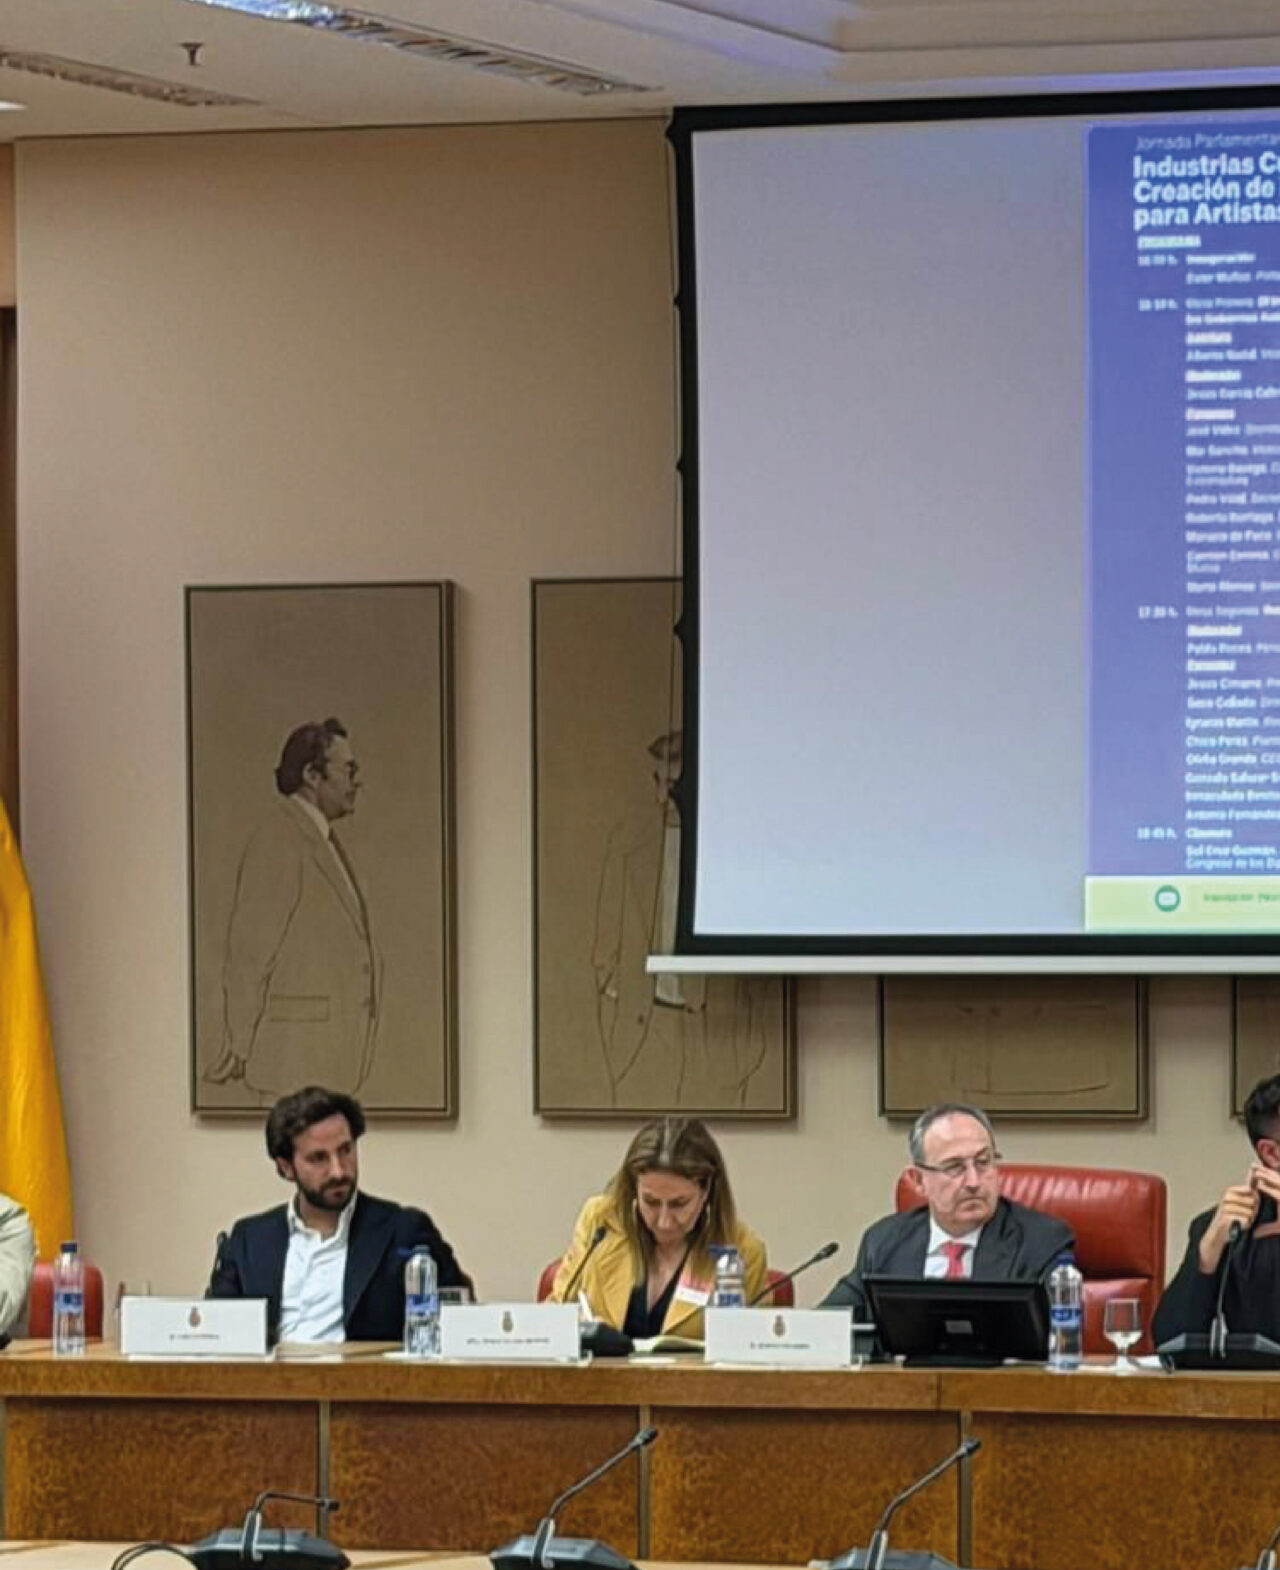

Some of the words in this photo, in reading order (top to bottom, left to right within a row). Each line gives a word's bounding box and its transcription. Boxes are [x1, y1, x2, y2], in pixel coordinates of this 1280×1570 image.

[1136, 135, 1191, 150] Jornada
[1133, 153, 1254, 179] Industrias
[1133, 175, 1240, 203] Creación
[1246, 174, 1274, 199] de
[1133, 206, 1188, 231] para
